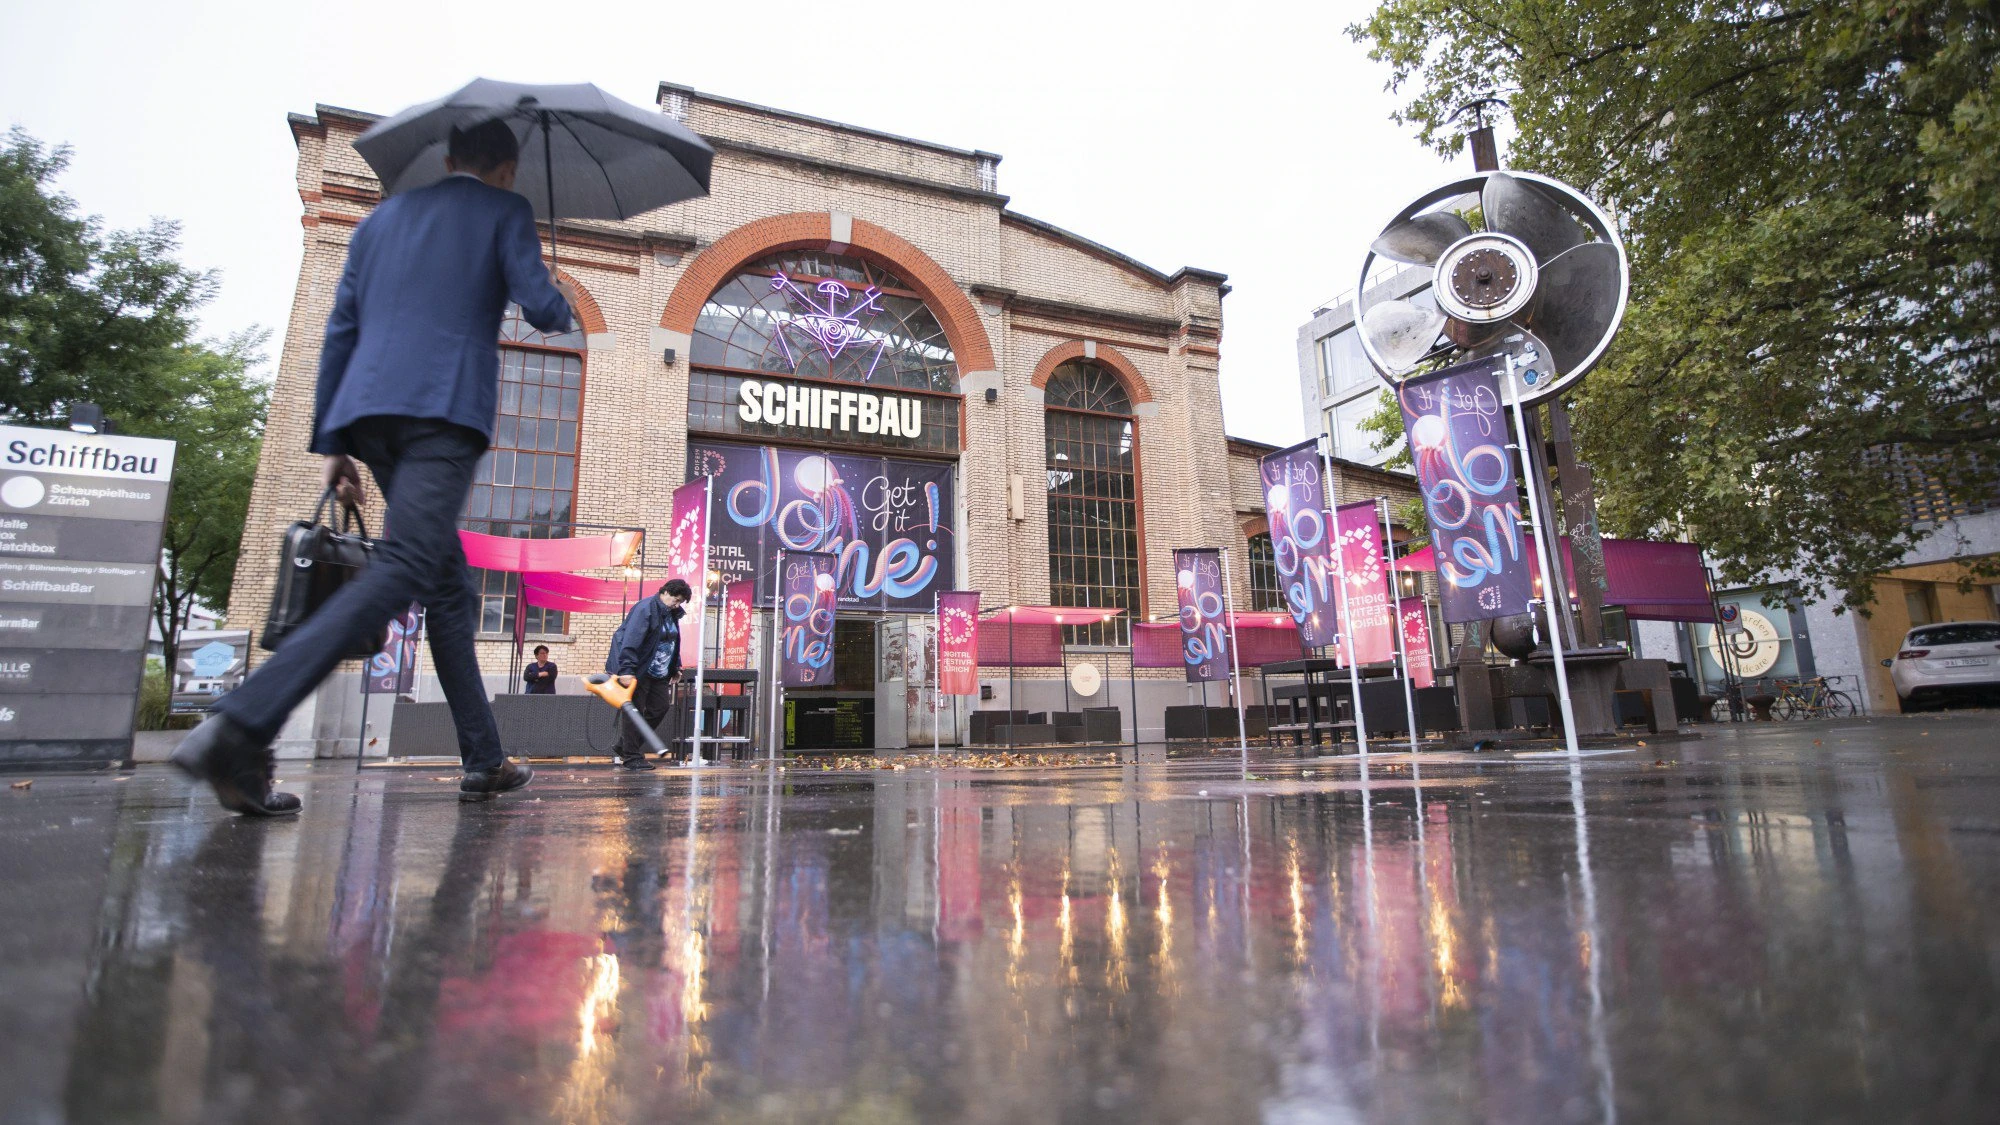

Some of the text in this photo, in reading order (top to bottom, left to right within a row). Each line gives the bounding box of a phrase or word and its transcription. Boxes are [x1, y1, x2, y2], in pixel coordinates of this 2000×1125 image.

[738, 380, 922, 438] SCHIFFBAU
[7, 440, 158, 474] Schiffbau
[47, 494, 90, 507] Zürich
[51, 484, 151, 500] Schauspielhaus
[862, 476, 916, 532] Get it
[2, 580, 95, 593] SchiffbauBar
[786, 562, 812, 590] Get
[0, 615, 40, 628] urmBar
